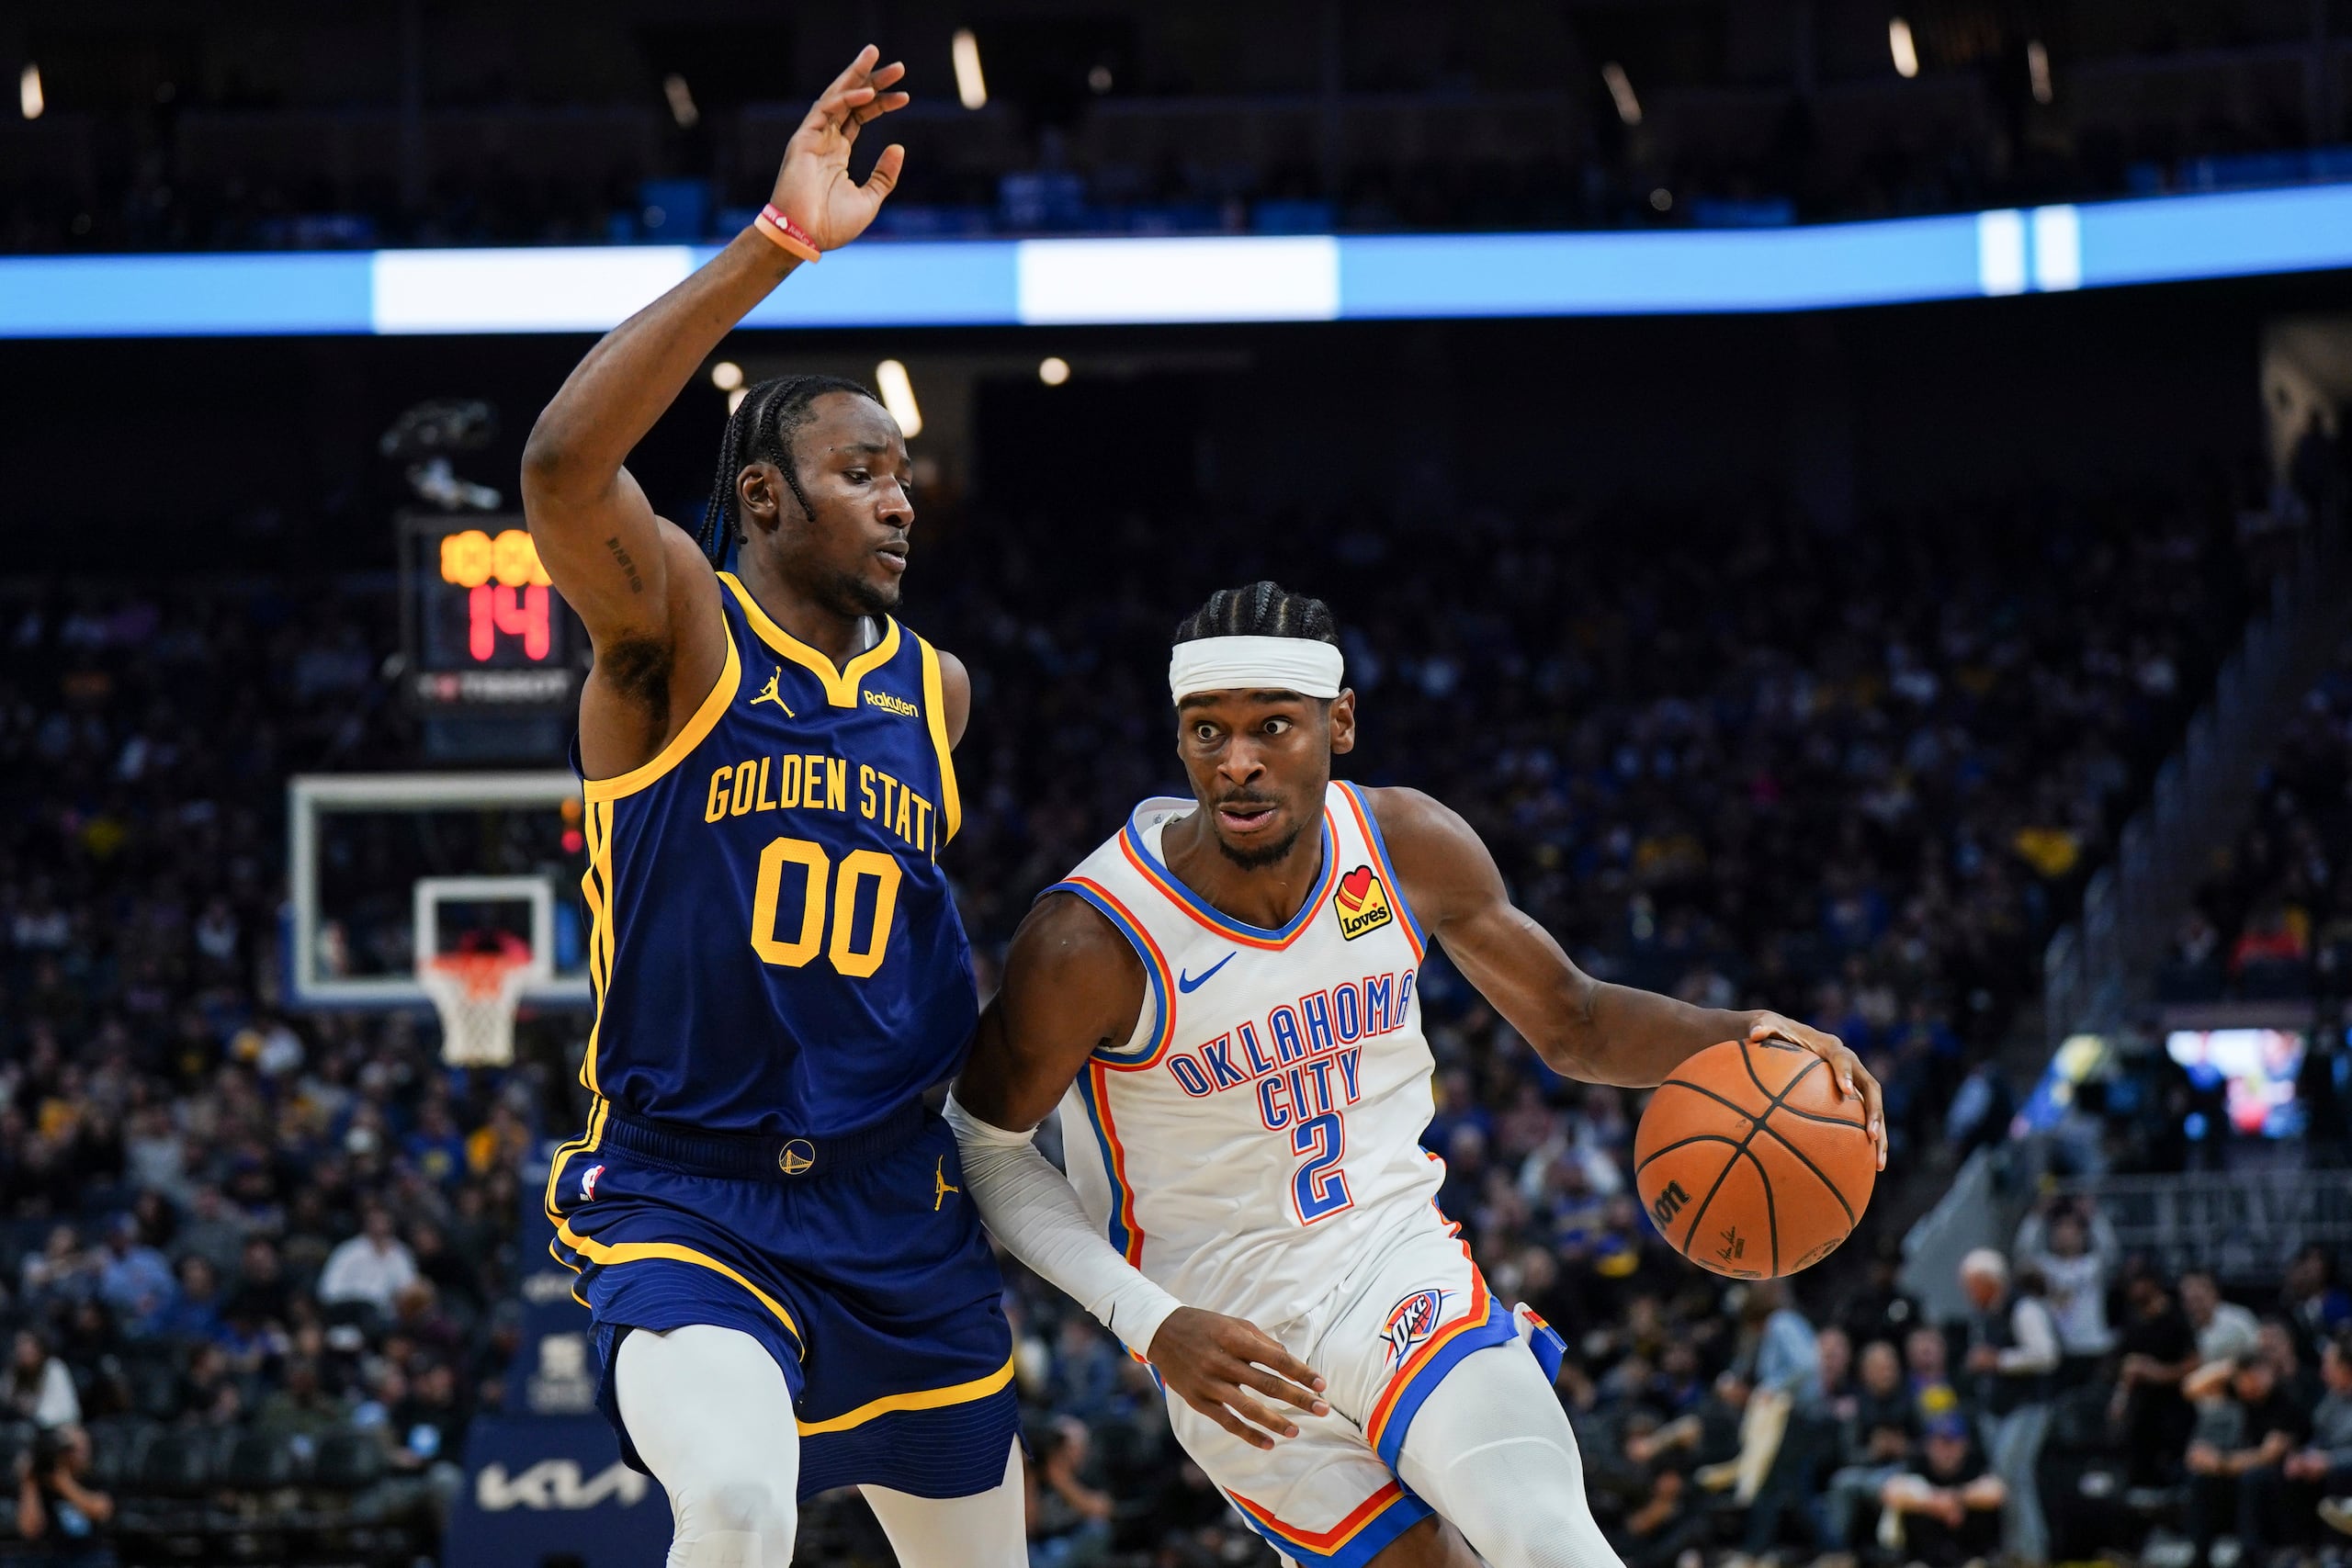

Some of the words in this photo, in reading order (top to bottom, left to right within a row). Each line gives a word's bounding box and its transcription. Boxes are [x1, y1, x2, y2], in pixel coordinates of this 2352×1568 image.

[469, 583, 550, 662] 14
[863, 689, 920, 718] Rakuten
[704, 753, 847, 824] GOLDEN
[859, 763, 938, 868] STAT
[750, 836, 903, 979] 00
[1166, 968, 1415, 1099] OKLAHOMA
[1257, 1044, 1363, 1132] CITY
[1291, 1109, 1354, 1227] 2
[1391, 1293, 1429, 1359] OKC
